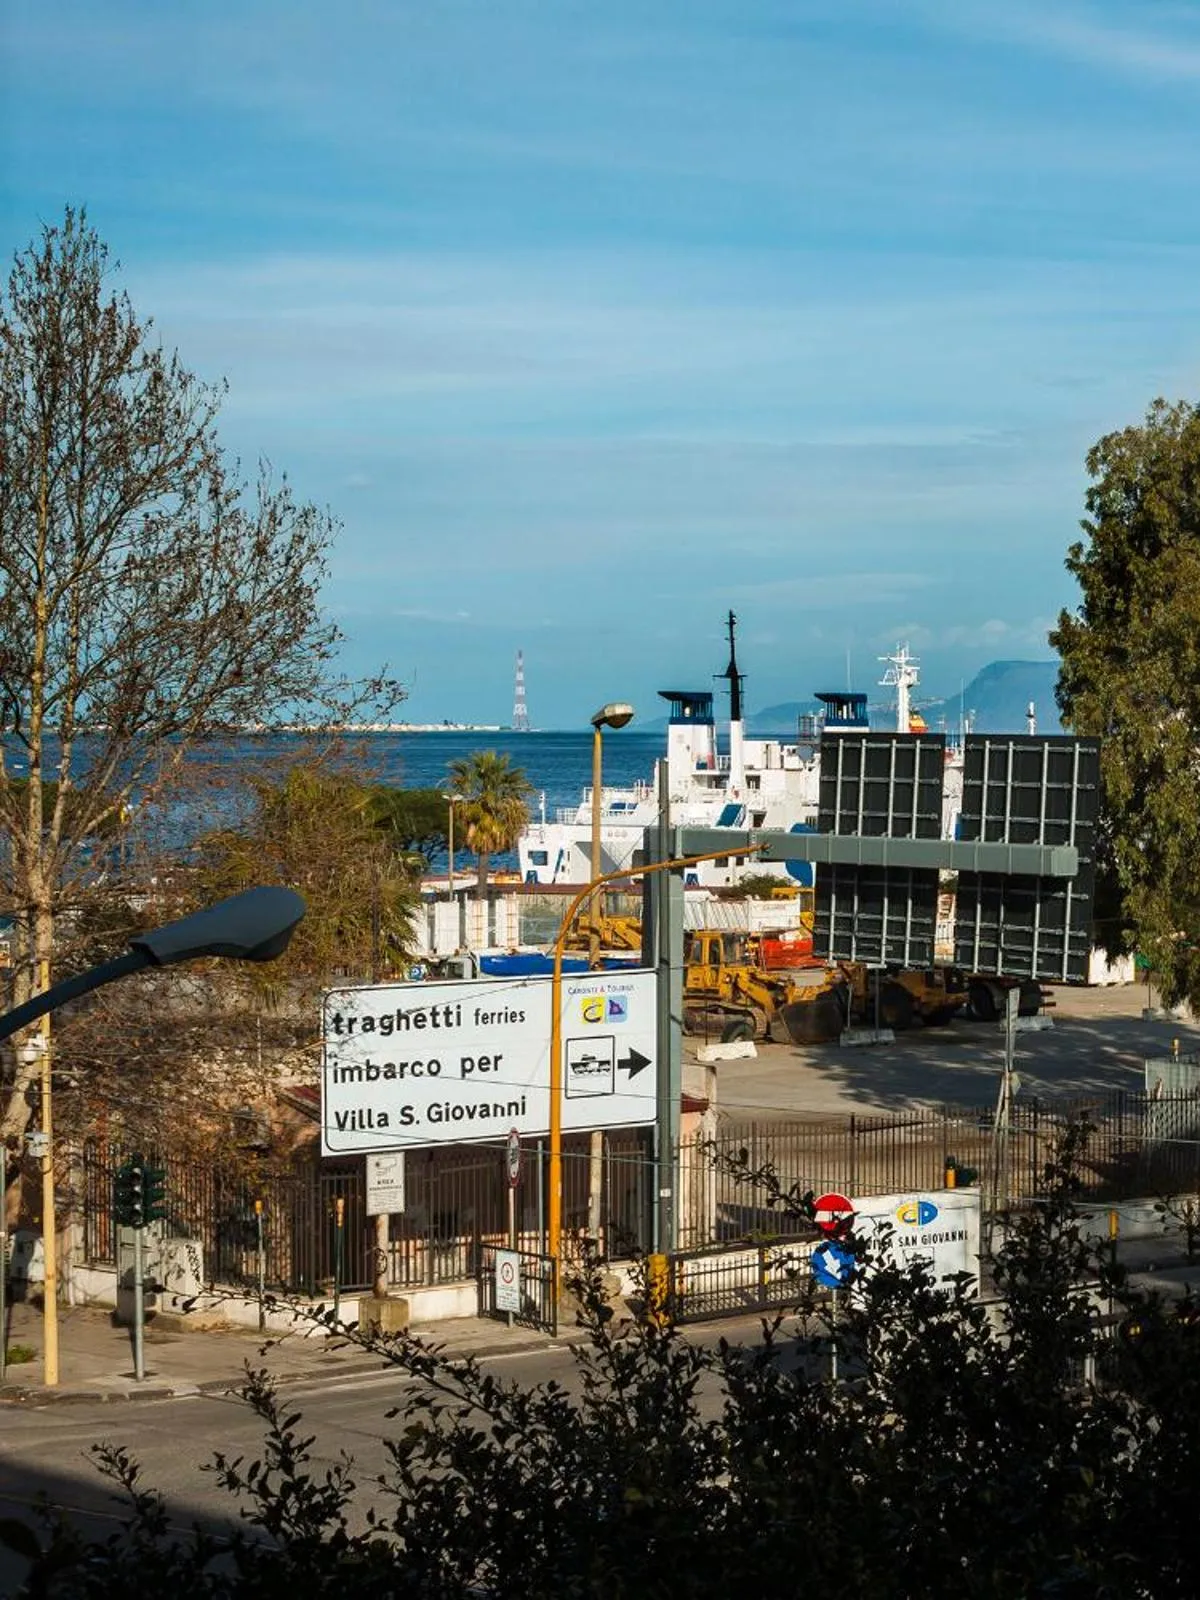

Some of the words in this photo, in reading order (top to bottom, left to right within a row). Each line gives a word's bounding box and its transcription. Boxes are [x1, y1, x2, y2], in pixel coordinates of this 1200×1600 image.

[332, 1004, 463, 1037] traghetti
[474, 1005, 526, 1027] ferries
[332, 1056, 442, 1085] imbarco
[460, 1052, 504, 1079] per
[334, 1109, 390, 1132] Villa
[399, 1105, 421, 1127] S.
[427, 1095, 527, 1124] Giovanni
[898, 1235, 918, 1248] SAN
[921, 1229, 969, 1246] GIOVANNI
